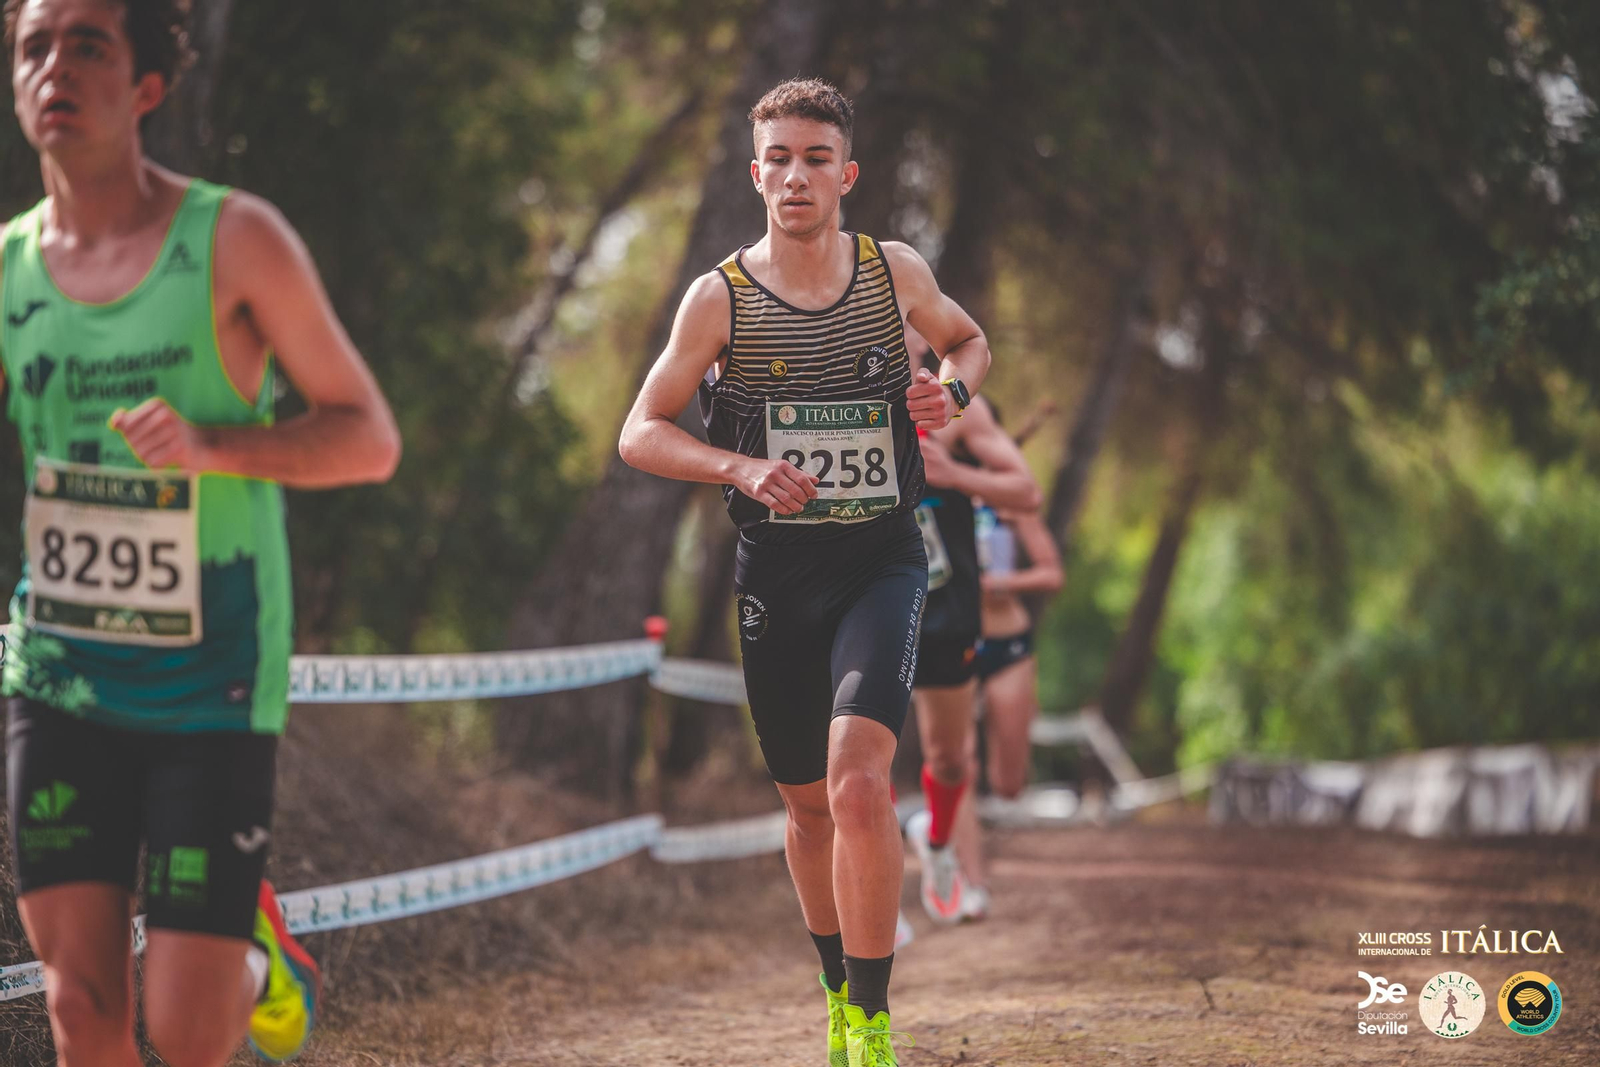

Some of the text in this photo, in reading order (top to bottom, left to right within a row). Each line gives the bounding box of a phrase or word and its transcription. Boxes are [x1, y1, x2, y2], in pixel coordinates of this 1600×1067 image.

[870, 346, 888, 358] JOVEN
[804, 405, 863, 422] ITÁLICA
[40, 526, 181, 594] 8295
[745, 594, 766, 612] JOVEN
[898, 587, 923, 682] CLUB DE ATLETISMO
[905, 647, 917, 692] JOVEN
